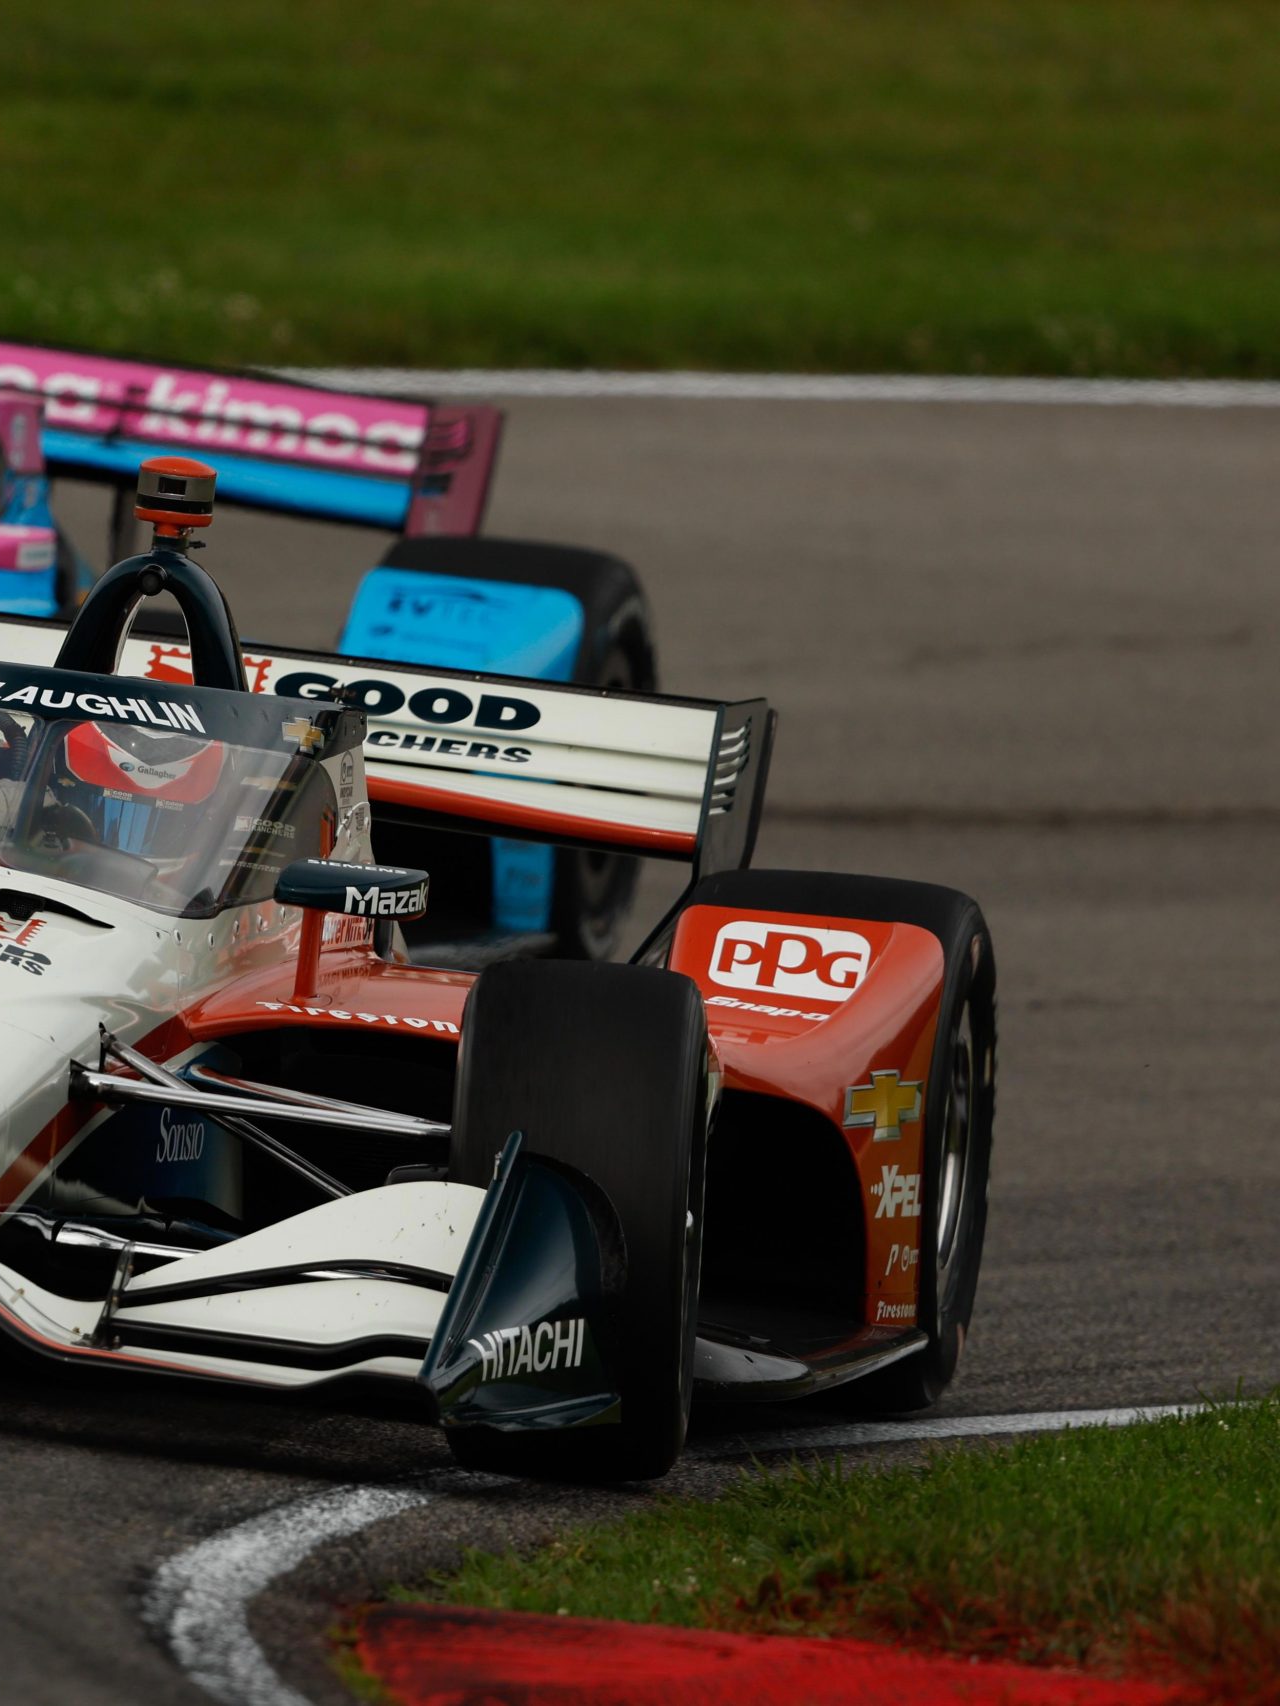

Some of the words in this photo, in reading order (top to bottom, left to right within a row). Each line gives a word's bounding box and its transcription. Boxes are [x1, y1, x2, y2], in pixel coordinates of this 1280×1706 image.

[144, 374, 426, 469] kimoa
[274, 671, 542, 731] GOOD
[368, 730, 534, 764] CHERS
[137, 765, 177, 780] Gallagher
[253, 818, 296, 832] GOOD
[307, 858, 408, 875] SIEMENS
[344, 882, 428, 915] Mazak
[717, 930, 863, 990] PPG
[255, 1001, 461, 1034] Fireston
[703, 995, 831, 1021] Snap-o
[156, 1107, 205, 1162] Sonsio
[875, 1165, 921, 1219] XPEL
[467, 1318, 585, 1381] HITACHI
